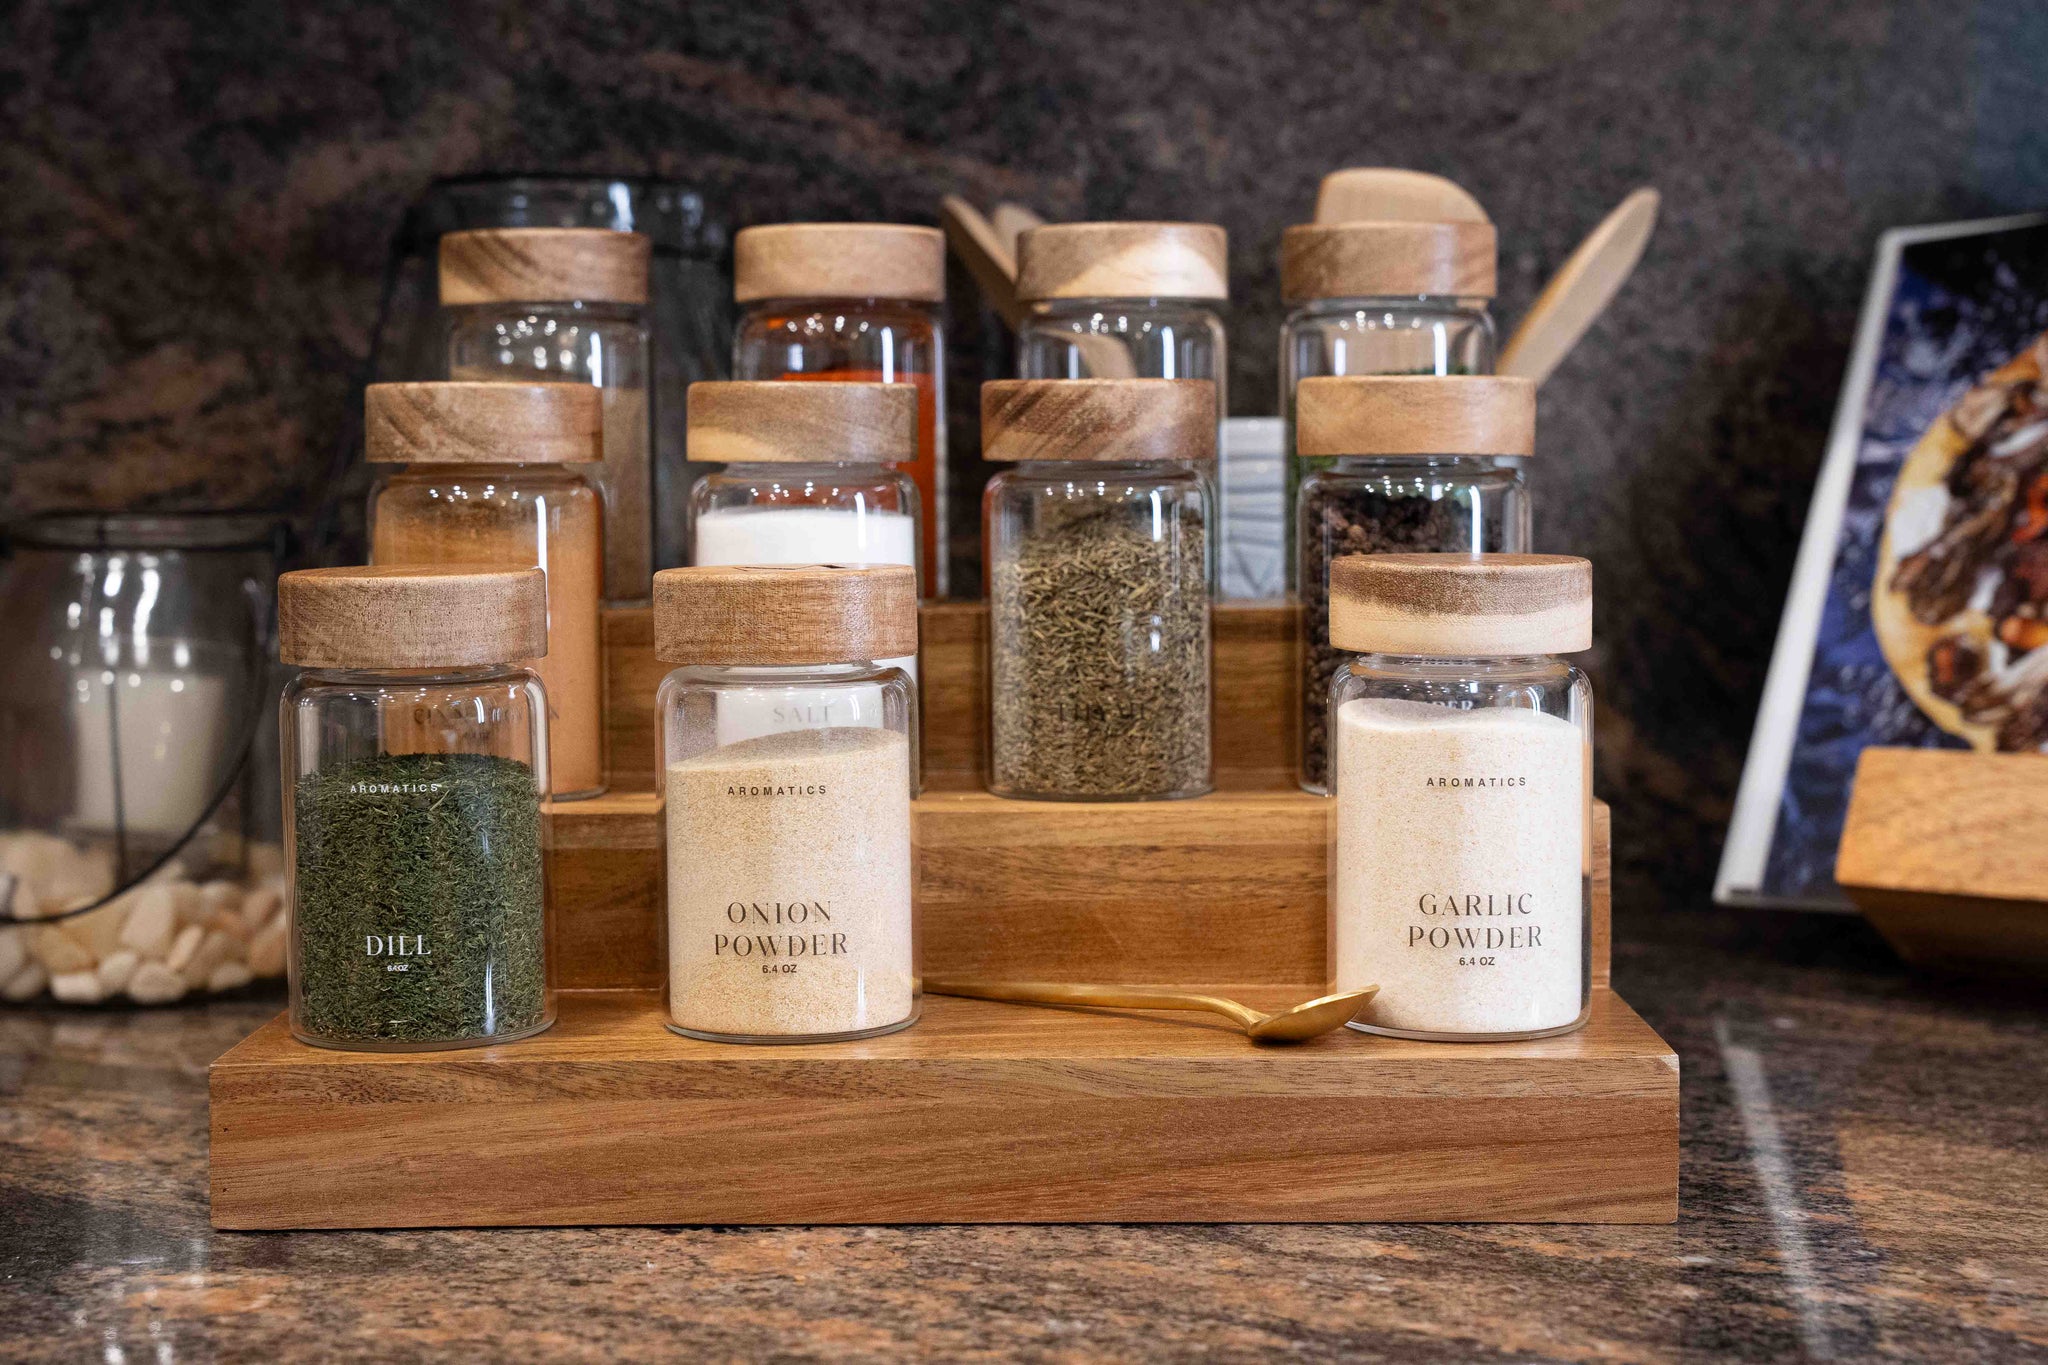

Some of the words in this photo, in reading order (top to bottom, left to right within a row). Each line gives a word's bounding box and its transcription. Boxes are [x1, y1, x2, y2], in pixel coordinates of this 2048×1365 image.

[773, 705, 832, 722] SALT
[350, 783, 438, 793] AROMATICS
[727, 785, 827, 796] AROMATICS
[1426, 777, 1526, 787] AROMATICS
[727, 901, 831, 924] ONION
[1419, 893, 1533, 916] GARLIC
[366, 934, 432, 956] DILL
[714, 933, 848, 957] POWDER
[1408, 925, 1542, 949] POWDER
[762, 964, 778, 974] 6.4
[782, 964, 798, 974] OZ
[1459, 957, 1476, 966] 6.4
[1479, 956, 1496, 966] OZ
